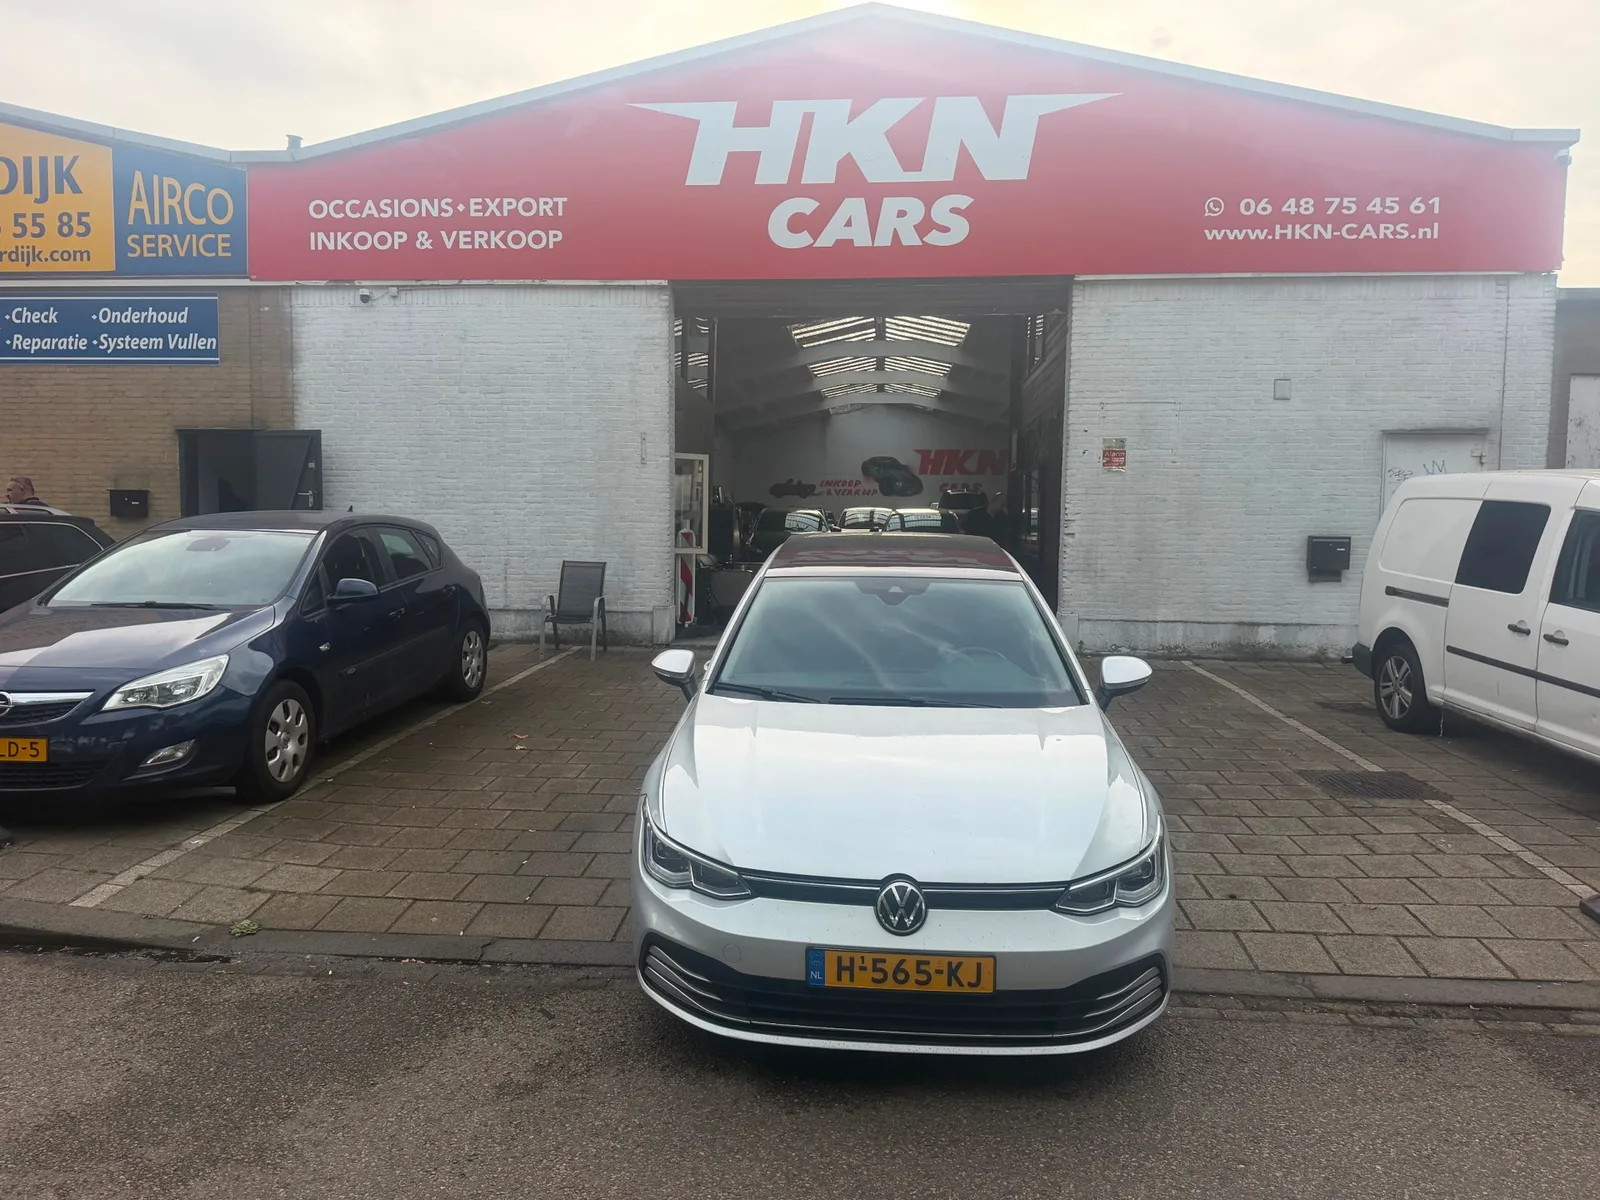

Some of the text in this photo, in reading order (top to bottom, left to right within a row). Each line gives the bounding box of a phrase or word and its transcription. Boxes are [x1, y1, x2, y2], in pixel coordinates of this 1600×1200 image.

[626, 93, 1124, 186] HKN
[127, 170, 234, 225] AIRCO
[1239, 196, 1440, 215] 06 48 75 45 61
[12, 212, 91, 238] 55 85
[768, 194, 974, 249] CARS
[1204, 222, 1439, 240] www.HKN-CARS.nl
[127, 234, 231, 257] SERVICE
[309, 230, 563, 250] INKOOP & VERKOOP
[11, 307, 189, 324] Check Onderhoud
[12, 333, 217, 353] Reparatie Systeem Vullen
[914, 449, 1006, 475] HKN
[820, 479, 862, 488] INKOOP
[834, 488, 879, 497] VERKOOP
[810, 970, 823, 980] NL
